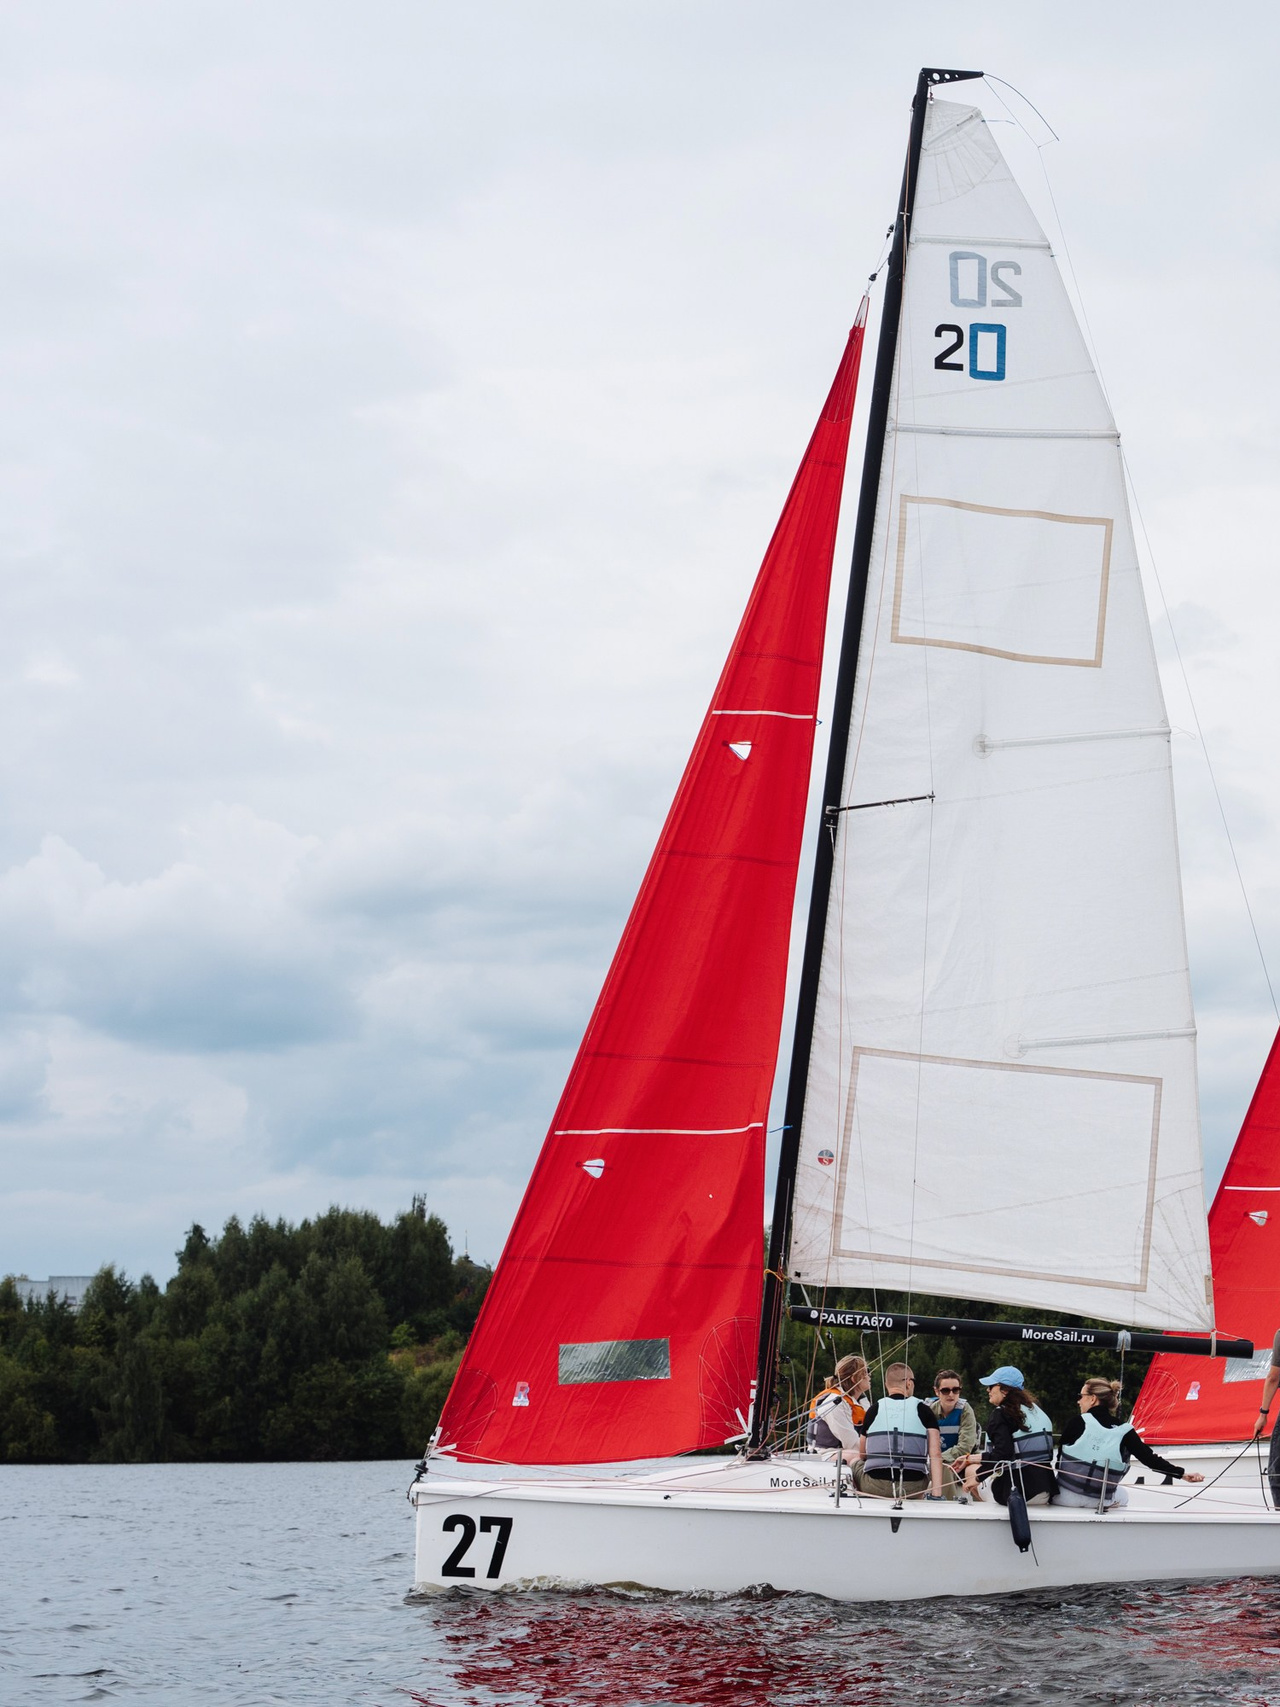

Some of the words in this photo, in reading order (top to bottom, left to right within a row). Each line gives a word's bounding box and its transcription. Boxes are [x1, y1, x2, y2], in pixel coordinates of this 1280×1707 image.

[934, 322, 1007, 381] 20
[1021, 1328, 1095, 1343] MoreSail.ru
[441, 1514, 513, 1579] 27
